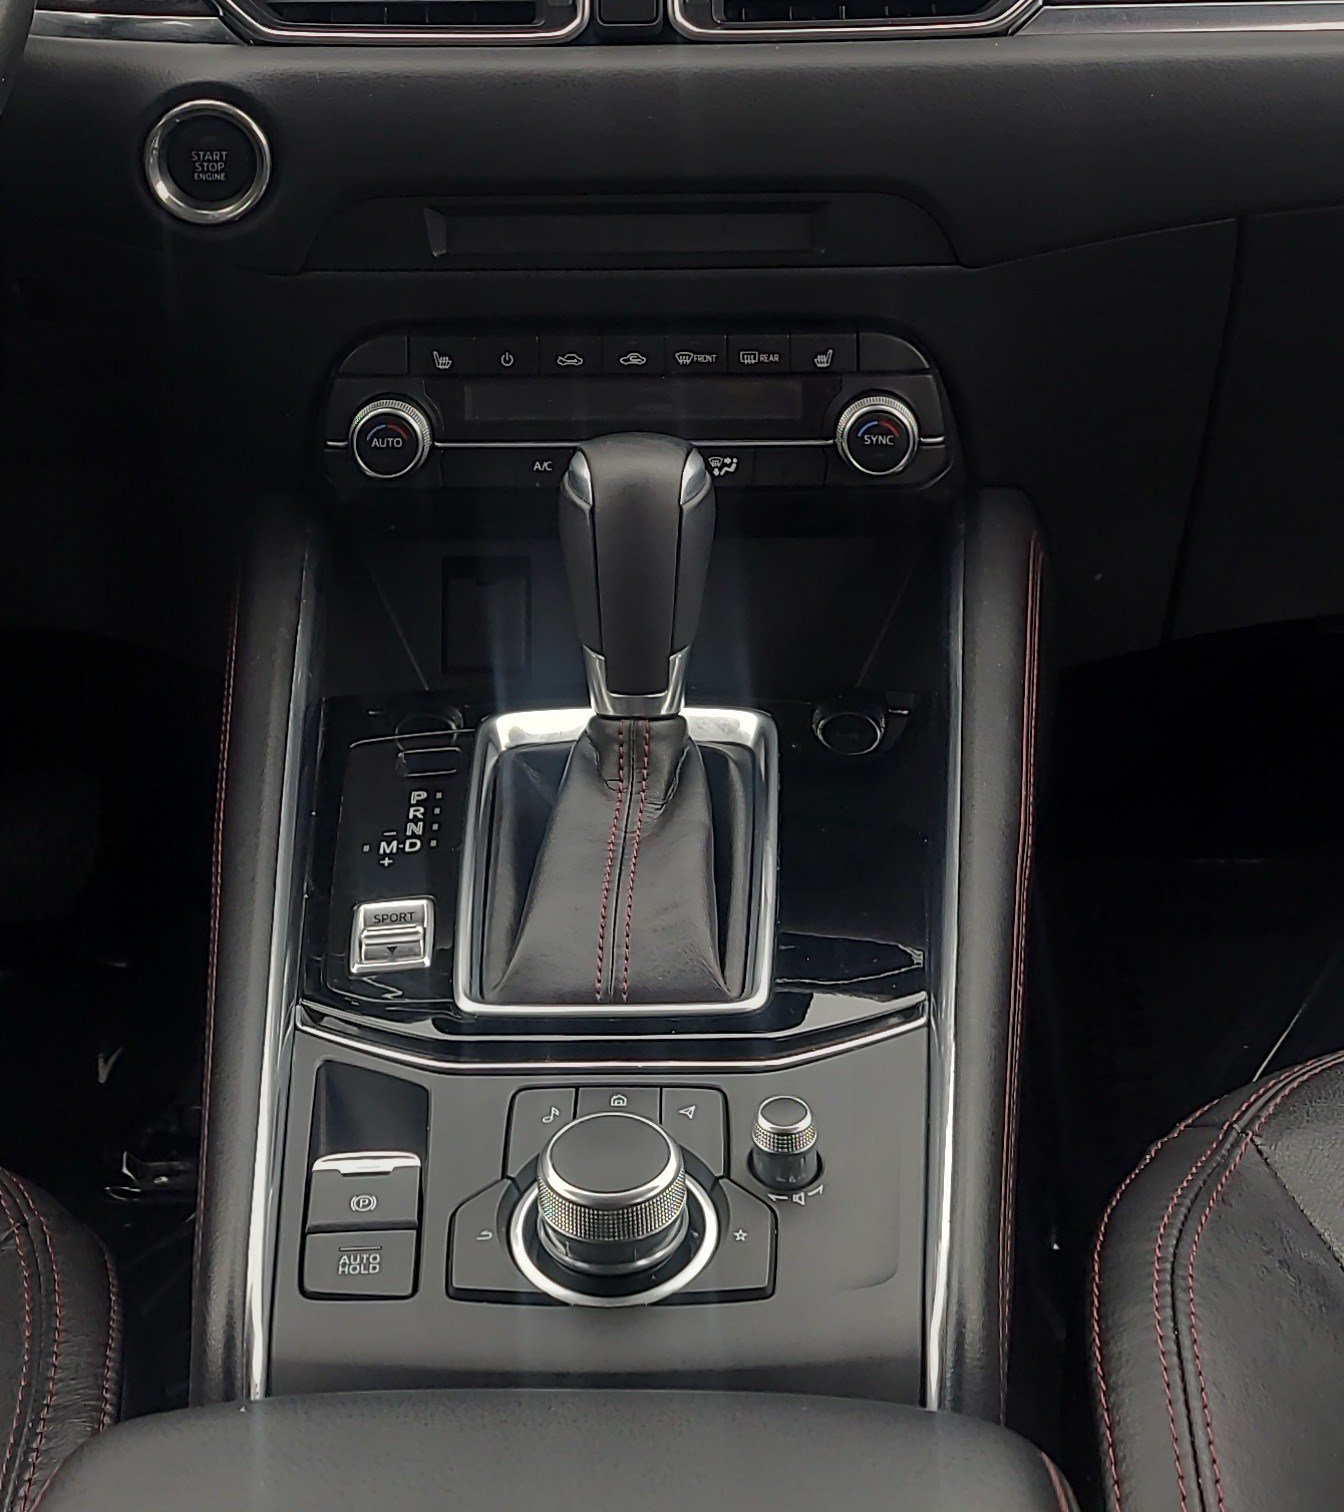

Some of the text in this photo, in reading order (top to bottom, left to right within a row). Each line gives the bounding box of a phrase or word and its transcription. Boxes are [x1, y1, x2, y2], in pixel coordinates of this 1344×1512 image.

[191, 151, 227, 161] START
[195, 162, 225, 172] STOP
[194, 172, 226, 180] ENGINE
[693, 354, 717, 362] FRONT
[759, 354, 780, 362] REAR
[371, 437, 403, 448] AUTO
[864, 435, 894, 445] SYNC
[533, 461, 553, 471] A/C
[410, 791, 428, 804] P
[408, 806, 425, 819] R
[405, 821, 423, 836] N
[373, 911, 415, 924] SPORT
[339, 1253, 381, 1265] AUTO
[338, 1264, 380, 1275] HOLD
